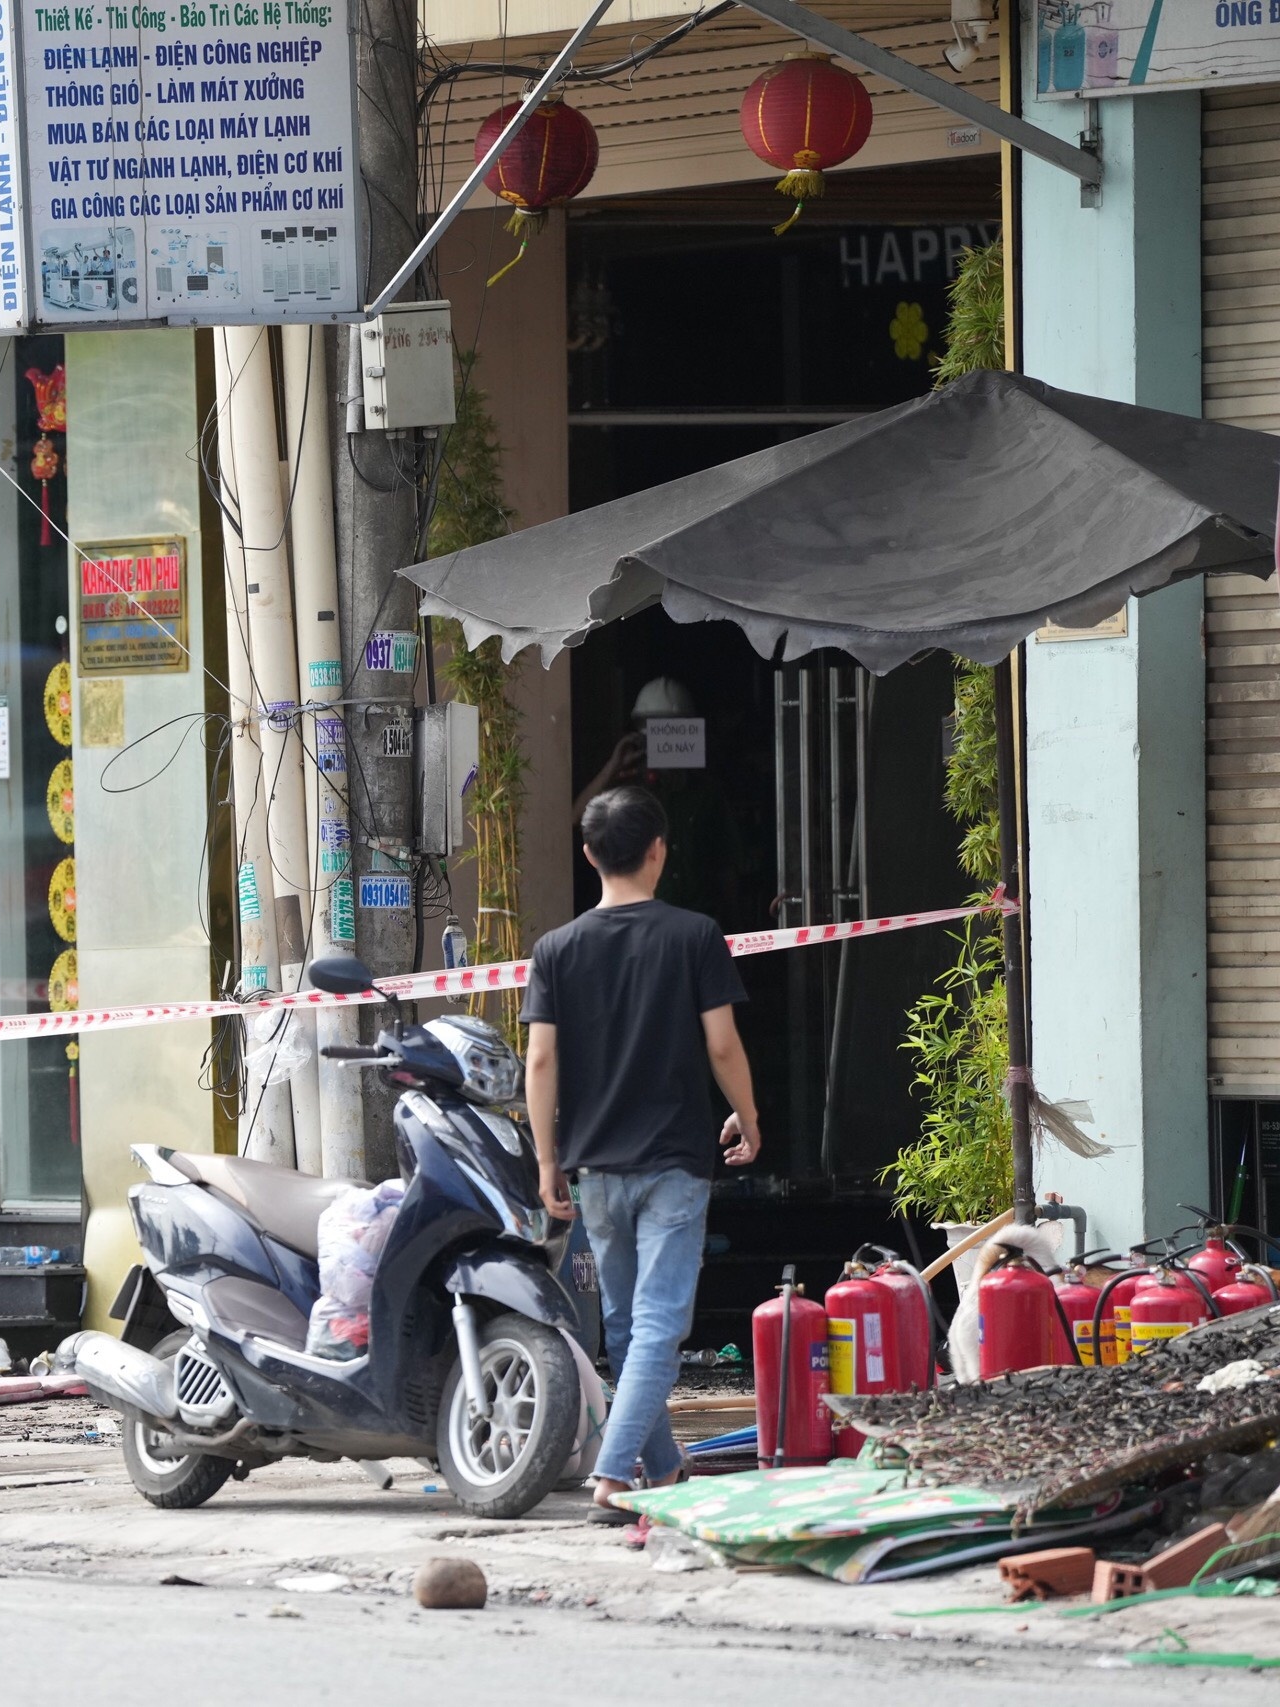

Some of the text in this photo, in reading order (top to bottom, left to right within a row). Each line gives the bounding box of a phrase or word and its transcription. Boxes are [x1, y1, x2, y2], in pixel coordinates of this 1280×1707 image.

[35, 7, 71, 32] Thiết
[74, 3, 94, 31] Kế
[106, 6, 130, 30] Thi
[132, 4, 166, 31] Công
[180, 3, 206, 28] Bảo
[209, 3, 229, 27] Trì
[233, 2, 259, 26] Các
[263, 2, 281, 30] Hệ
[286, 0, 332, 27] Thống:
[44, 47, 86, 70] ĐIỆN
[91, 46, 138, 72] LẠNH
[155, 43, 198, 71] ĐIỆN
[203, 40, 251, 65] CÔNG
[256, 36, 322, 67] NGHIỆP
[45, 82, 104, 107] THÔNG
[110, 80, 139, 105] GIÓ
[157, 79, 196, 104] LÀM
[201, 77, 239, 102] MÁT
[244, 71, 305, 101] XƯỞNG
[47, 113, 311, 145] MUA BÁN CÁC LOẠI MÁY LẠNH
[48, 146, 343, 187] VẬT TƯ NGÀNH LẠNH, ĐIỆN CƠ KHÍ
[51, 181, 344, 220] GIA CÔNG CÁC LOẠI SẢN PHẨM CƠ KHÍ
[3, 242, 19, 311] ĐIỆN
[82, 558, 134, 596] KARAOKE
[136, 556, 153, 592] AN
[650, 722, 686, 736] KHÔNG
